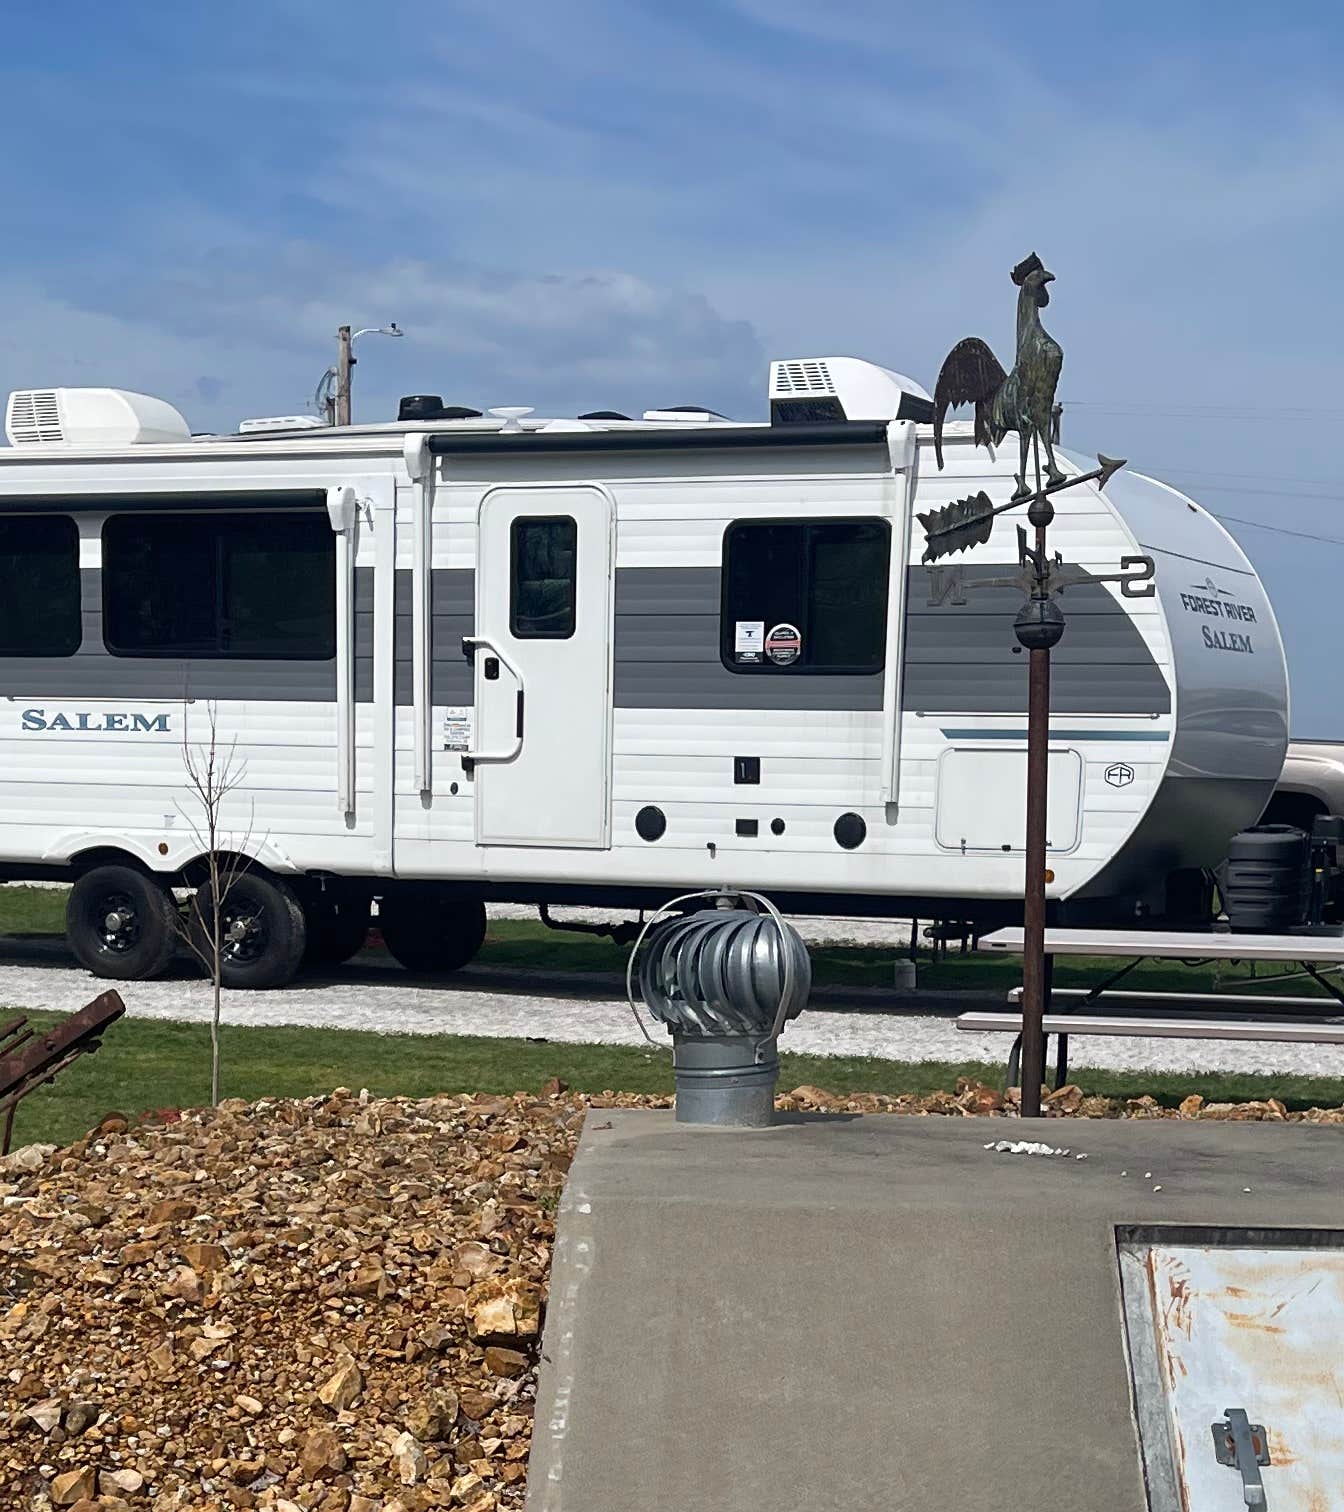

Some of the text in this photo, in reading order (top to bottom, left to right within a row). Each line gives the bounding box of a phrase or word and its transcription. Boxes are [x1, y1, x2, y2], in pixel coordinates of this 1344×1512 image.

[1180, 593, 1257, 624] FOREST RIVER
[1201, 624, 1254, 654] SALEM
[21, 709, 171, 732] SALEM
